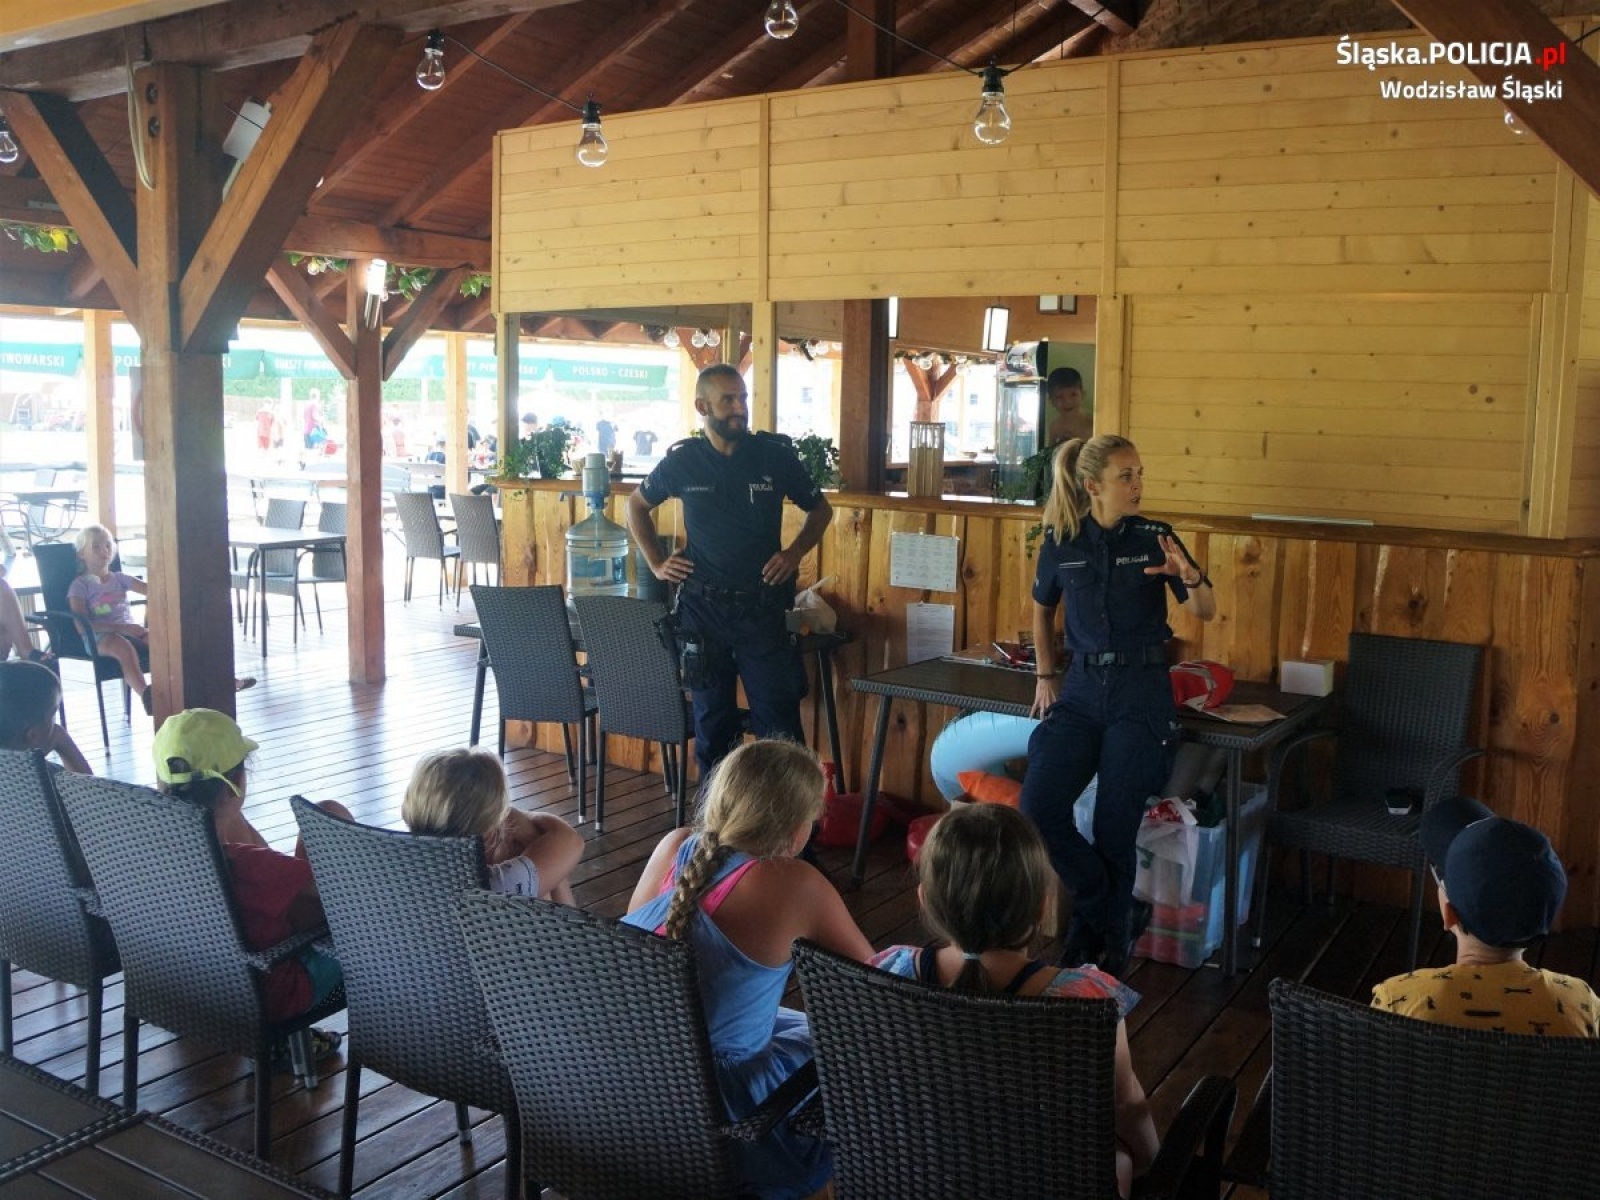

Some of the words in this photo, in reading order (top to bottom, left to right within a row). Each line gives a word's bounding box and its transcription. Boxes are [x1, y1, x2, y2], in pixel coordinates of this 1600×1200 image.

[0, 352, 64, 367] IWOWARSKI
[572, 365, 608, 376] POLSKO
[1115, 554, 1149, 566] POLICJA
